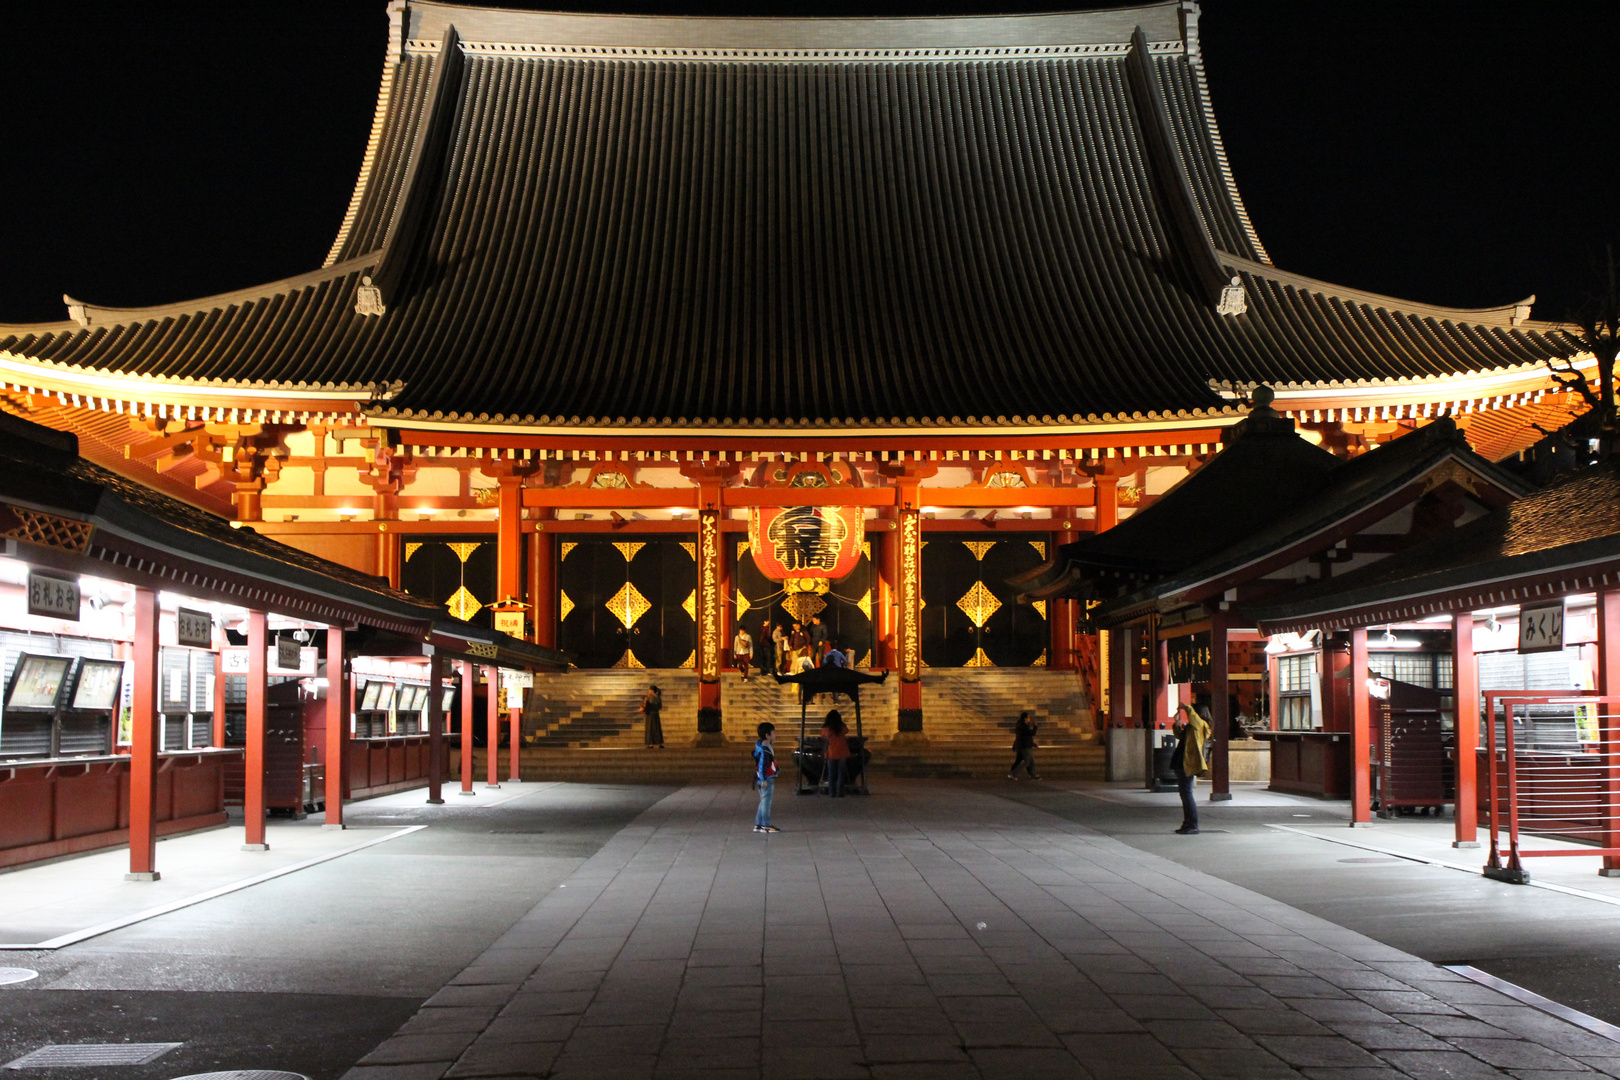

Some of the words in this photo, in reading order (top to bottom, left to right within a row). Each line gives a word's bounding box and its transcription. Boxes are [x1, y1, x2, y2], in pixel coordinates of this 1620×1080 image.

[32, 578, 75, 612] お札お守
[1526, 611, 1561, 641] みくじ
